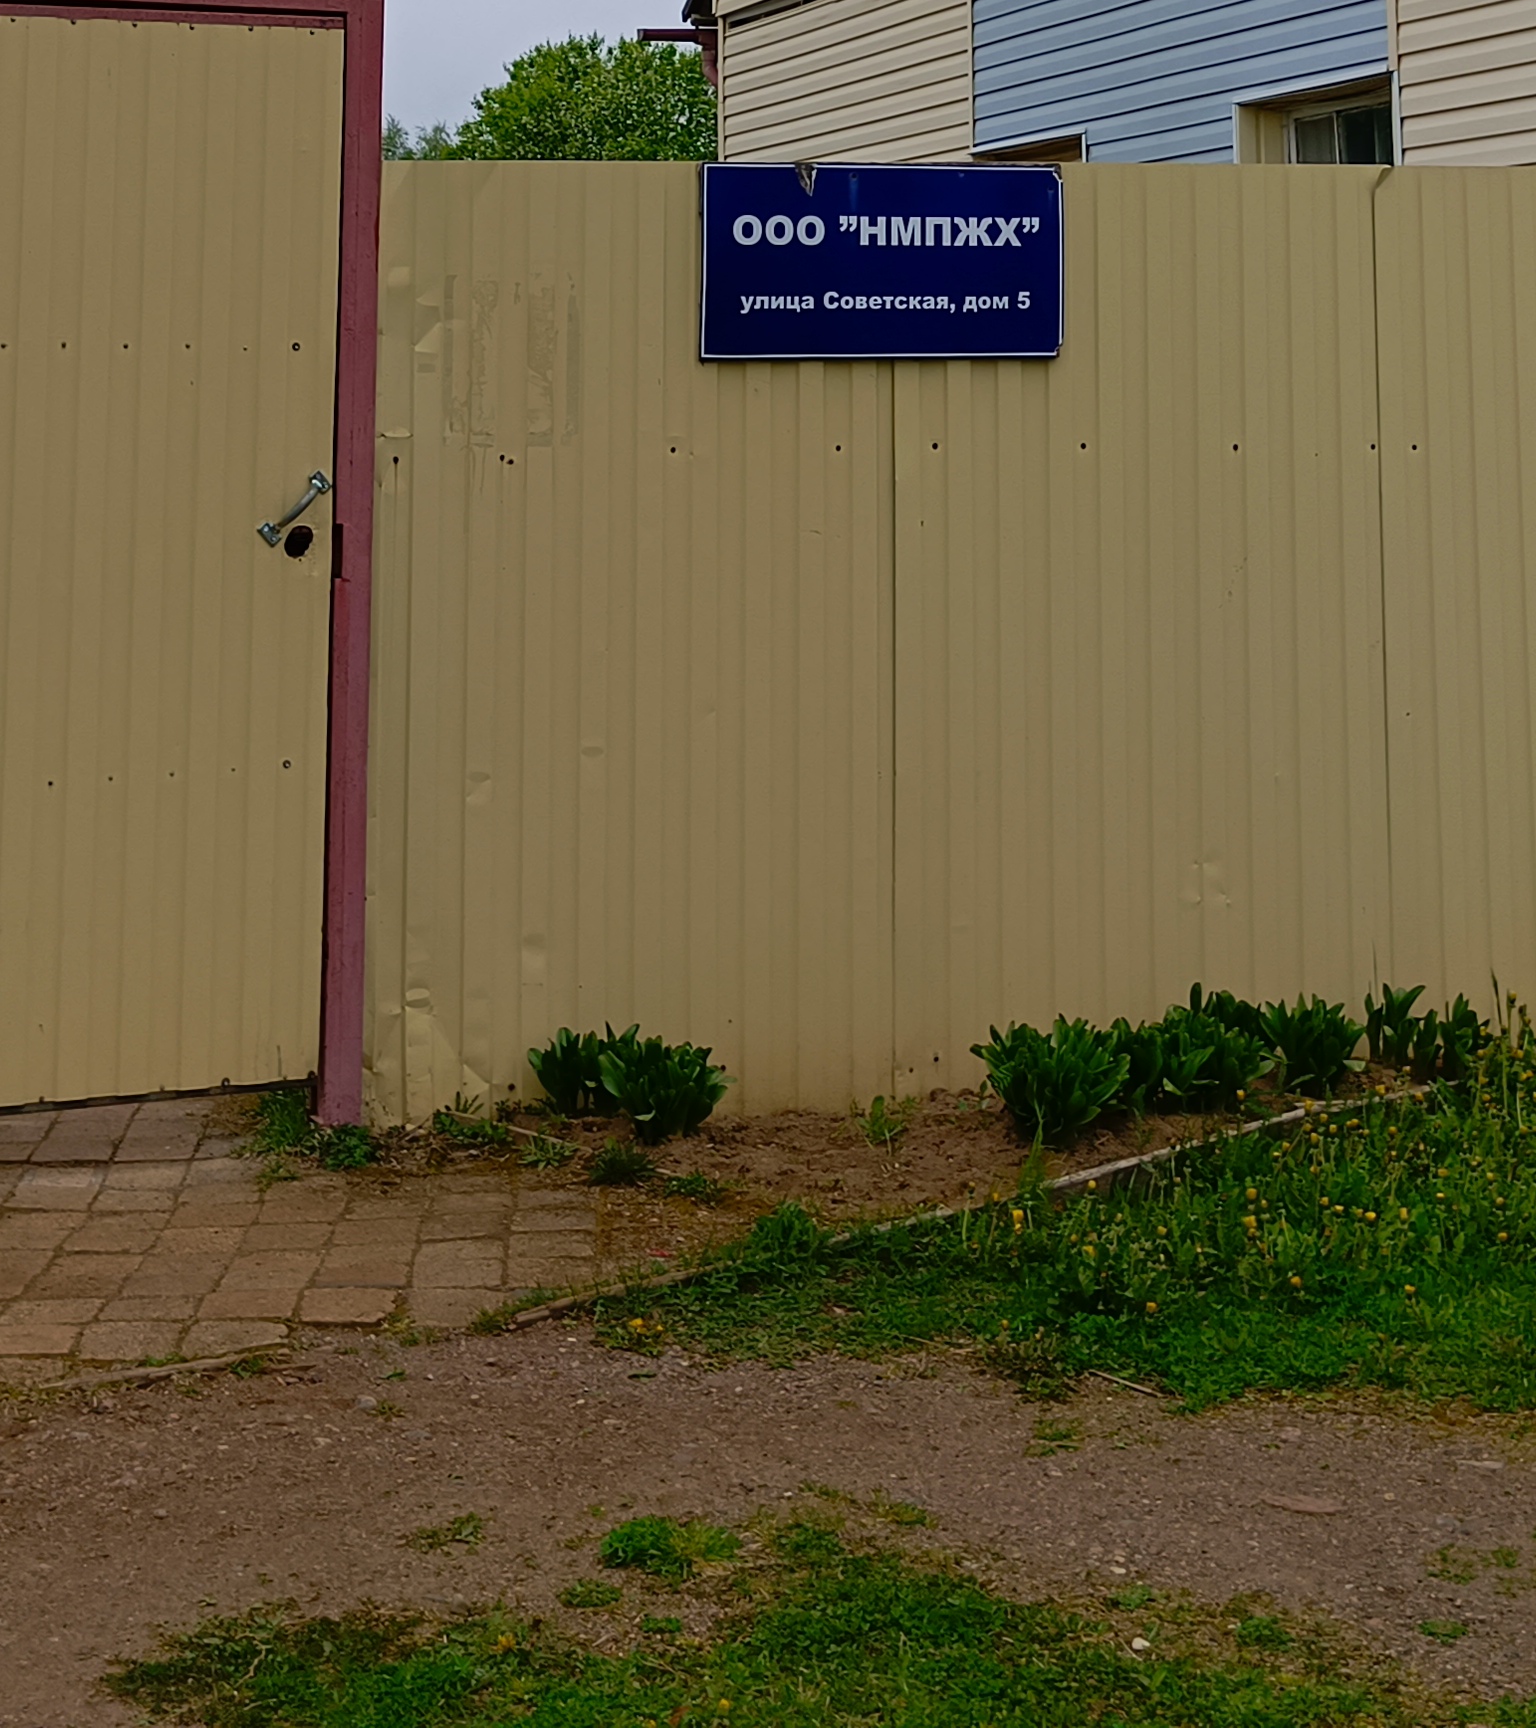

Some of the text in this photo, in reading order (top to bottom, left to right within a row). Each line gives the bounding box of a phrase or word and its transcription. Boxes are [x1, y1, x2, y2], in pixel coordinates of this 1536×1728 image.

[732, 214, 826, 246] ООО
[740, 291, 1031, 314] улица Советская, дом 5
